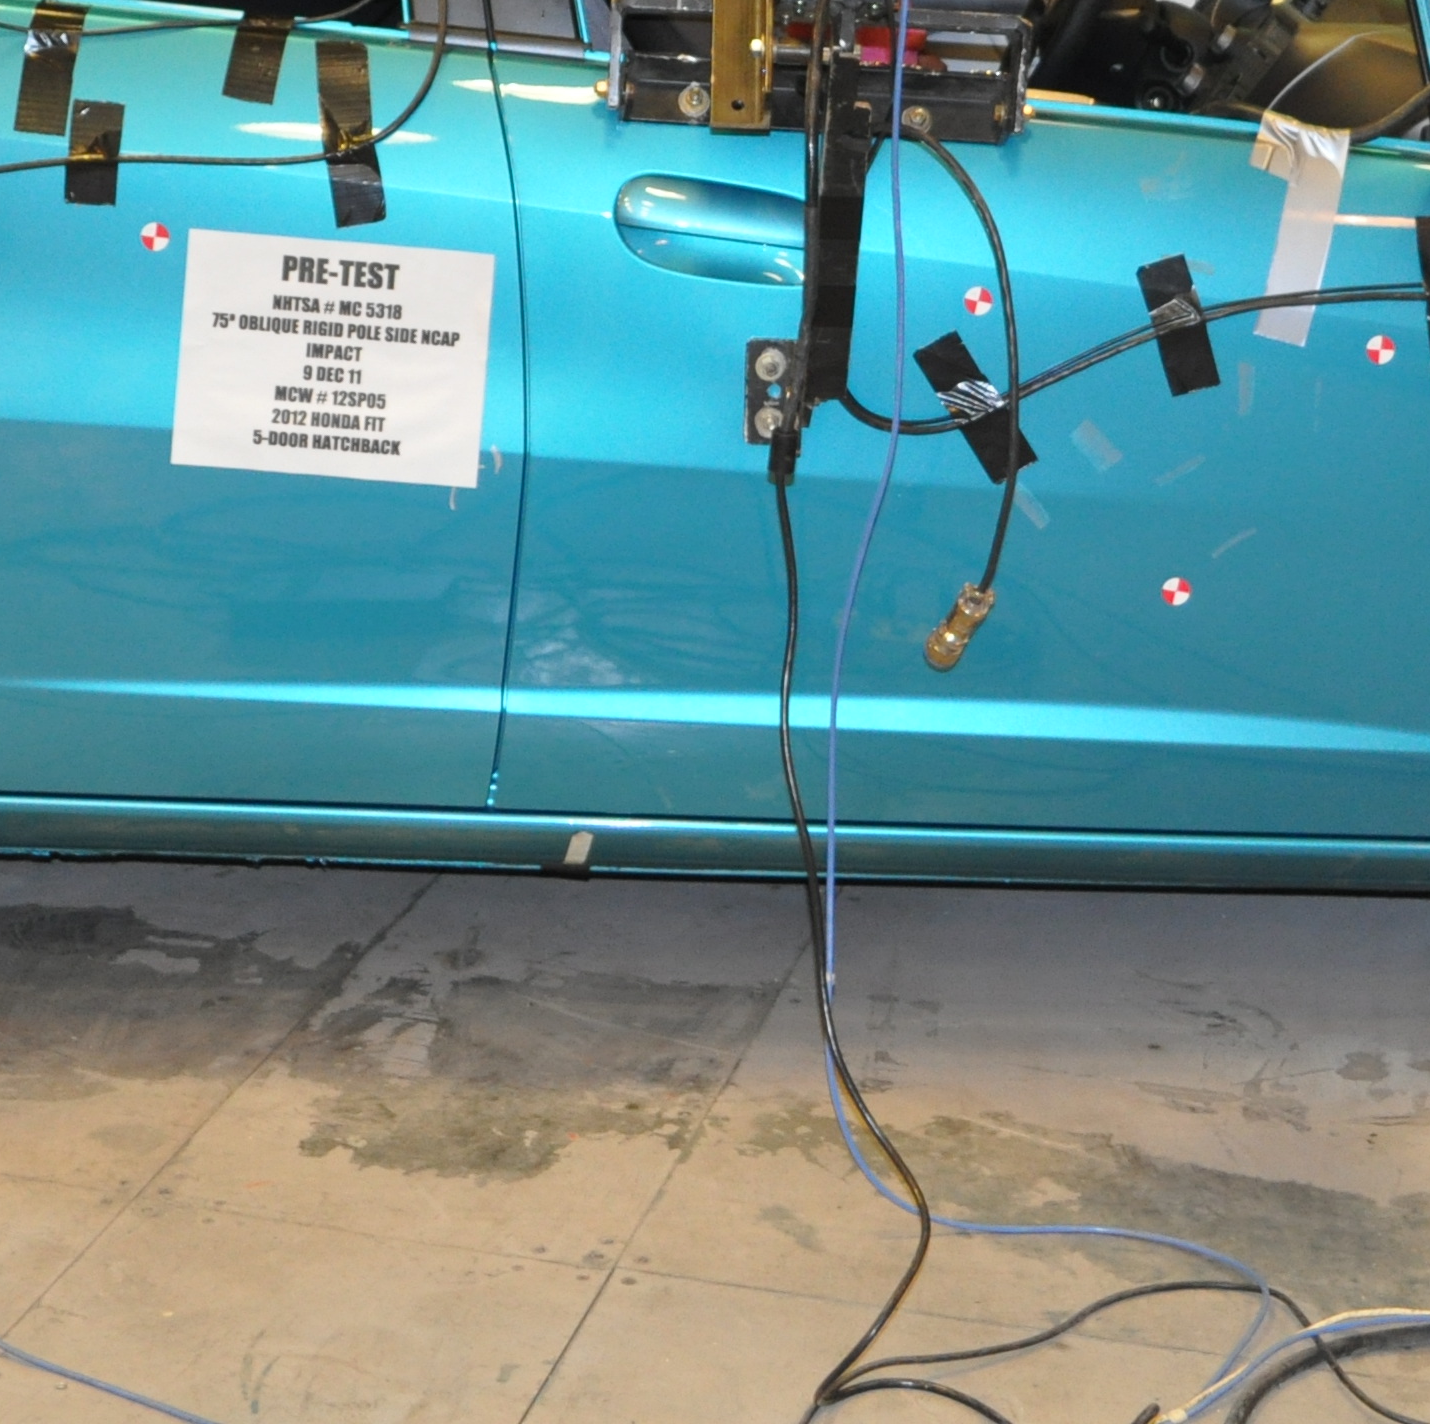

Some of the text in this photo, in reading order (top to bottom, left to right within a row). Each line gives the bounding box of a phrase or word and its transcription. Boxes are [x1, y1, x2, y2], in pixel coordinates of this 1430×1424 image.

[281, 255, 400, 290] PRE-TEST
[272, 295, 402, 320] NHTSA # MC 5318
[239, 315, 298, 335] OBLIQUE
[303, 322, 343, 337] RIGID
[347, 324, 381, 341] POLE
[385, 326, 417, 344] SIDE
[421, 330, 460, 347] NCAP
[306, 343, 362, 362] IMPACT
[303, 365, 362, 384] 9 DEC 11
[275, 386, 386, 410] MCW # 12SP05
[271, 409, 385, 432] 2012 HONDA FIT
[253, 430, 401, 456] 5-DOOR HATCHBACK
